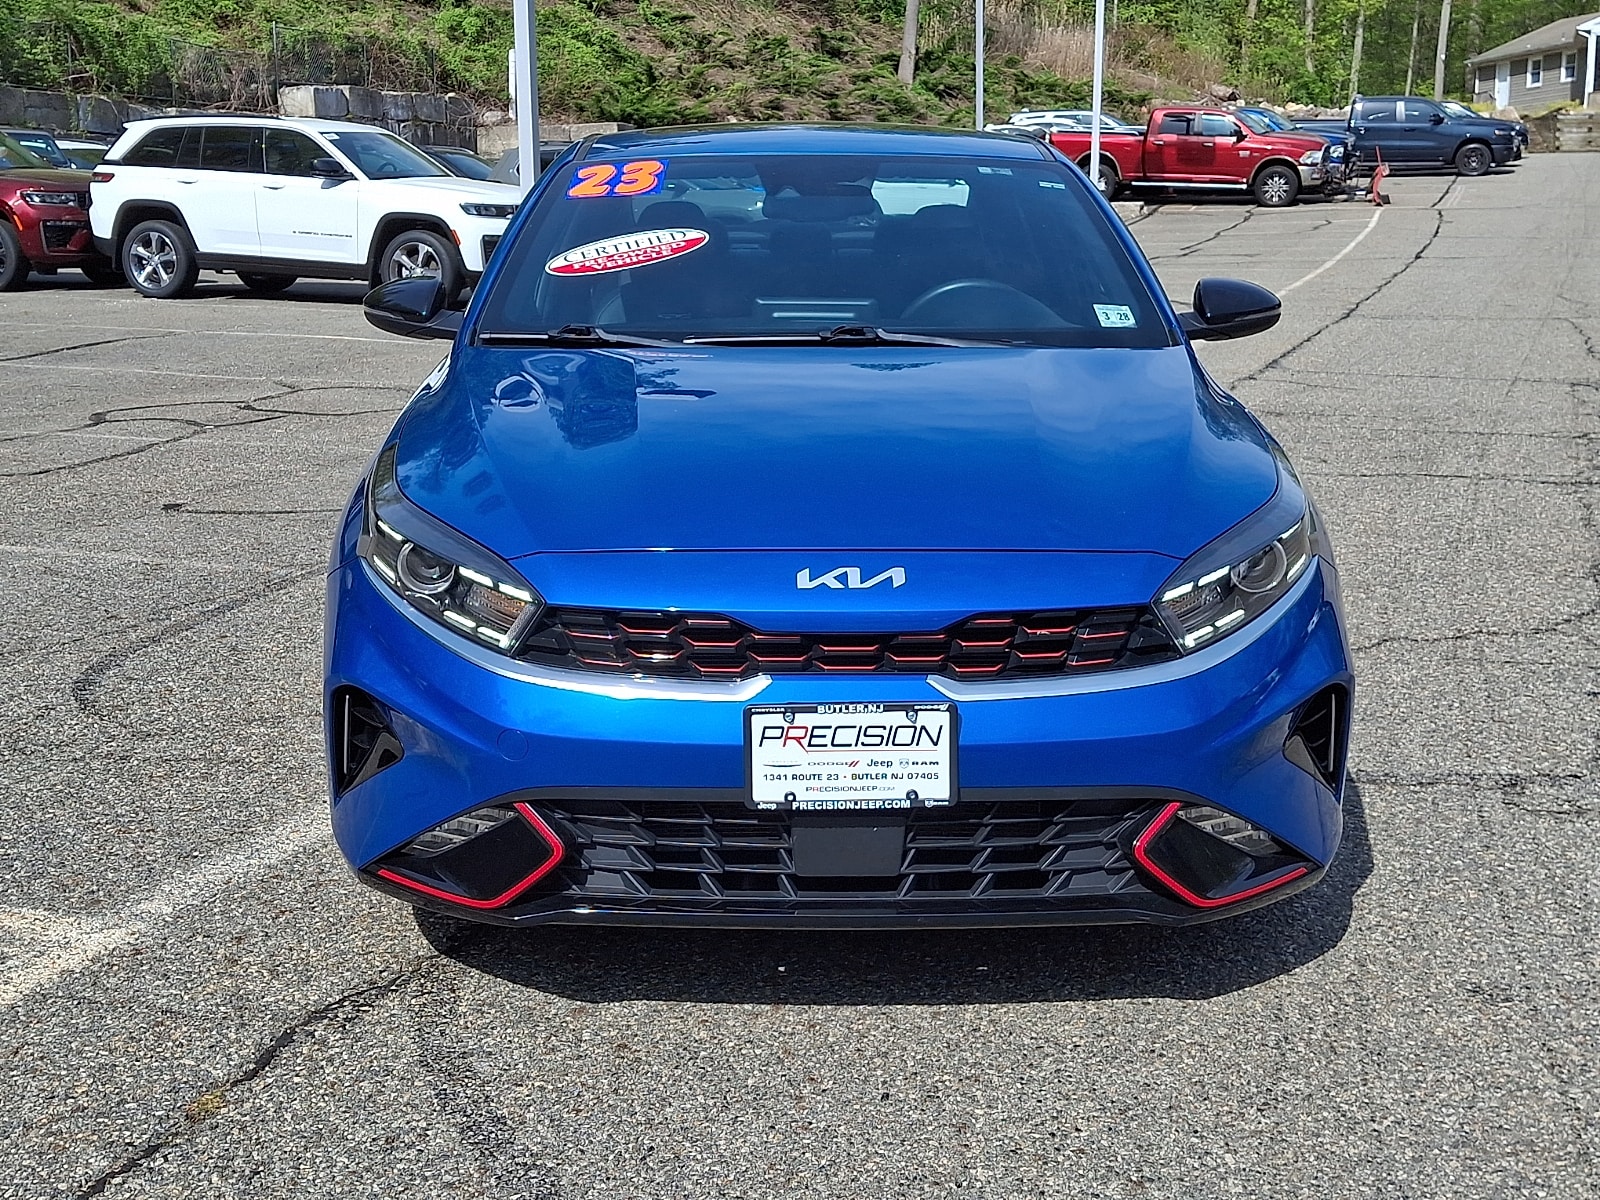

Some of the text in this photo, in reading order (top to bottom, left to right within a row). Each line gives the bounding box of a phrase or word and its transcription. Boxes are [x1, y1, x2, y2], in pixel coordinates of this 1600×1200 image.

[568, 160, 665, 197] 23
[563, 231, 687, 263] CERTIFIED
[572, 241, 687, 270] PRE-OWNED
[591, 249, 674, 270] VEHICLE
[1102, 311, 1130, 321] 3 28
[759, 725, 943, 753] PRECISION
[866, 758, 893, 769] Jeep
[763, 772, 939, 781] 1341 ROUTE 23 BUTLER NJ 07405
[757, 801, 777, 810] Jeep
[792, 800, 911, 810] PRECISIONJEEP.COM
